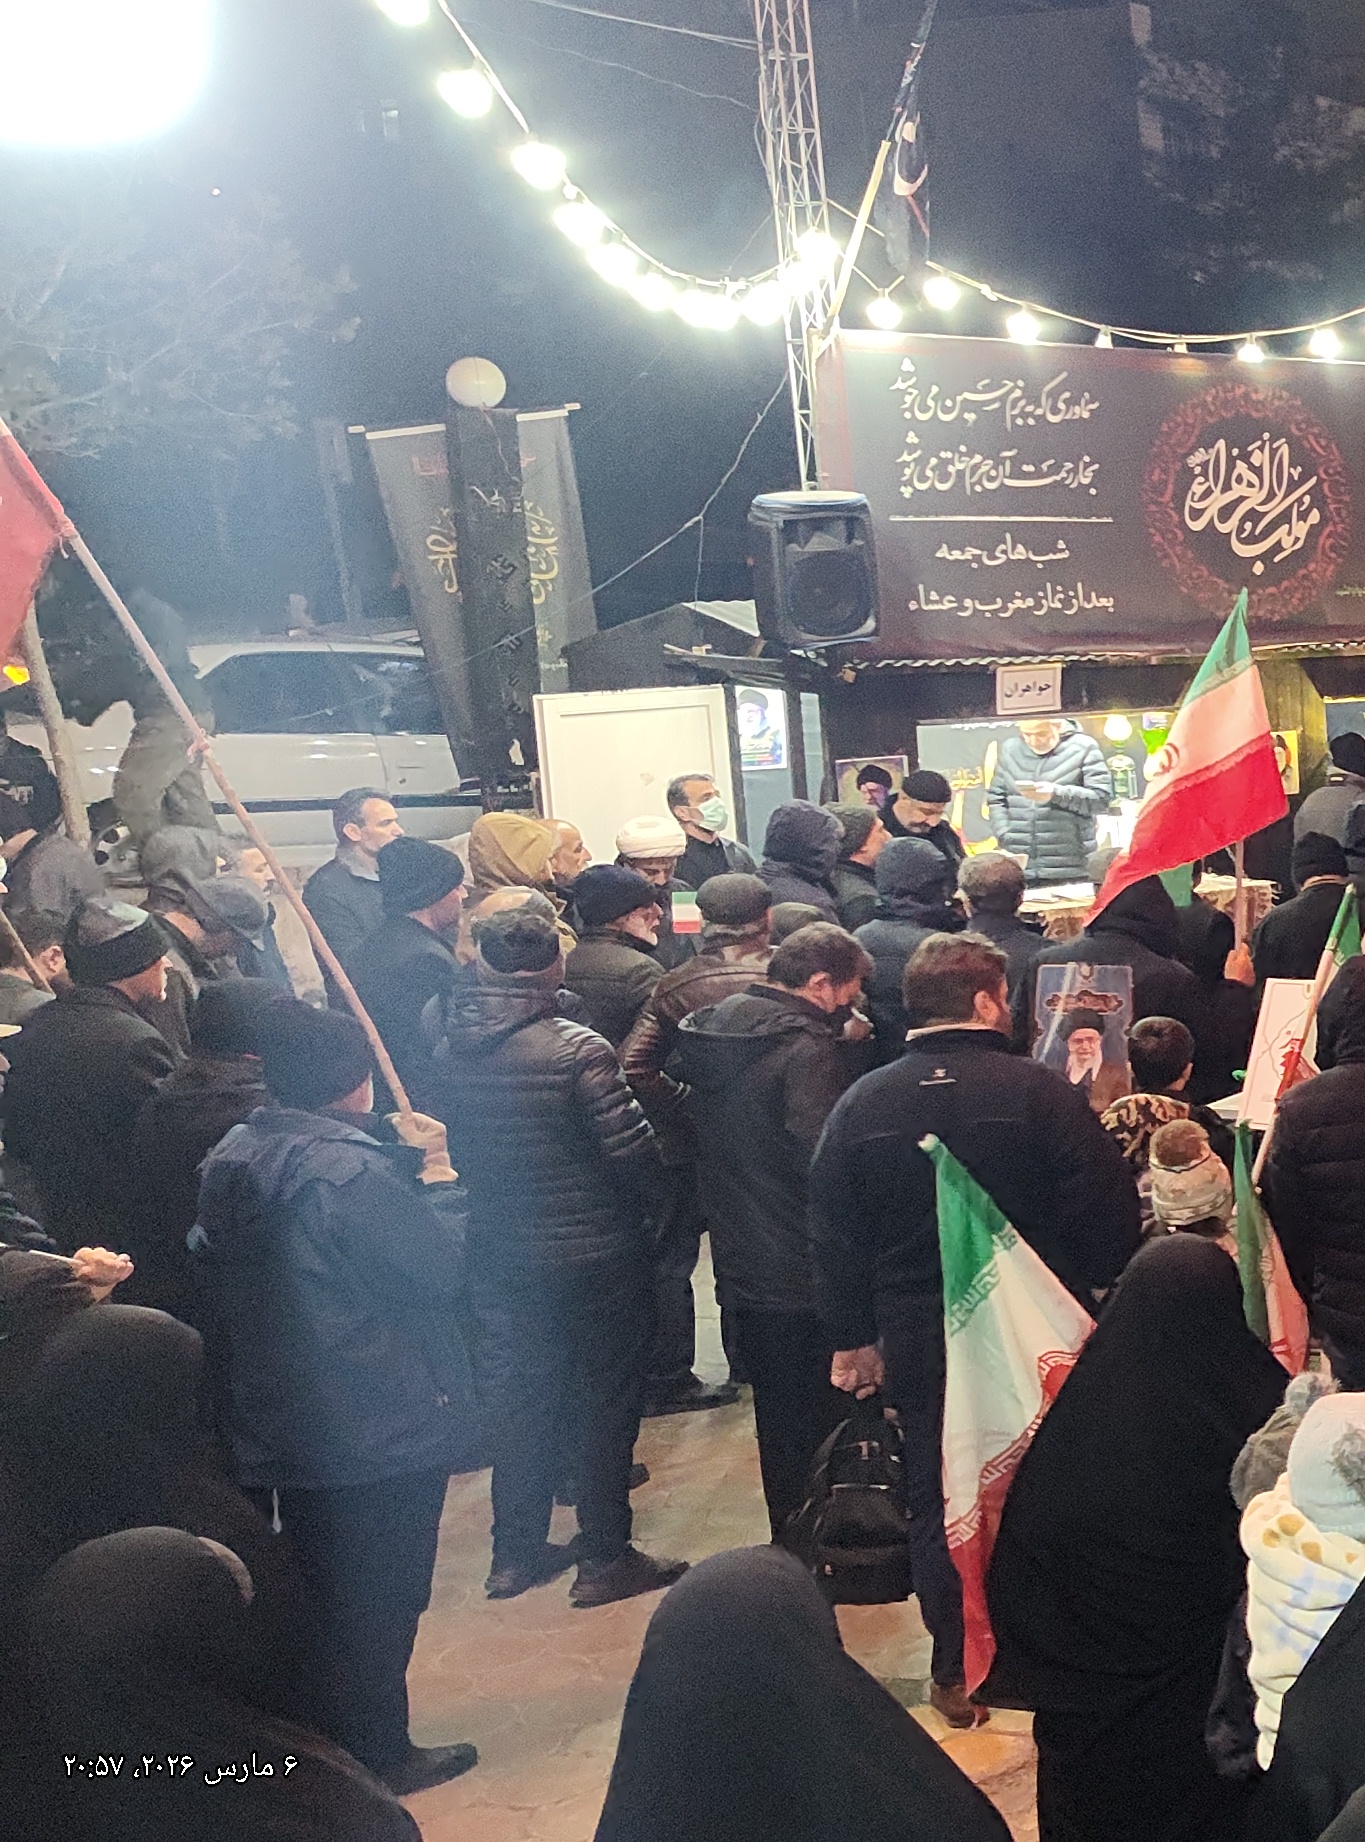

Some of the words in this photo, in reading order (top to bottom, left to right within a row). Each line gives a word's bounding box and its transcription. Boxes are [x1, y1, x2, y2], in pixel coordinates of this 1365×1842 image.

[936, 378, 1015, 427] حسین
[935, 542, 983, 569] جمعه
[908, 583, 959, 612] عشاء
[974, 591, 1035, 618] مغرب
[1033, 582, 1065, 616] نماز
